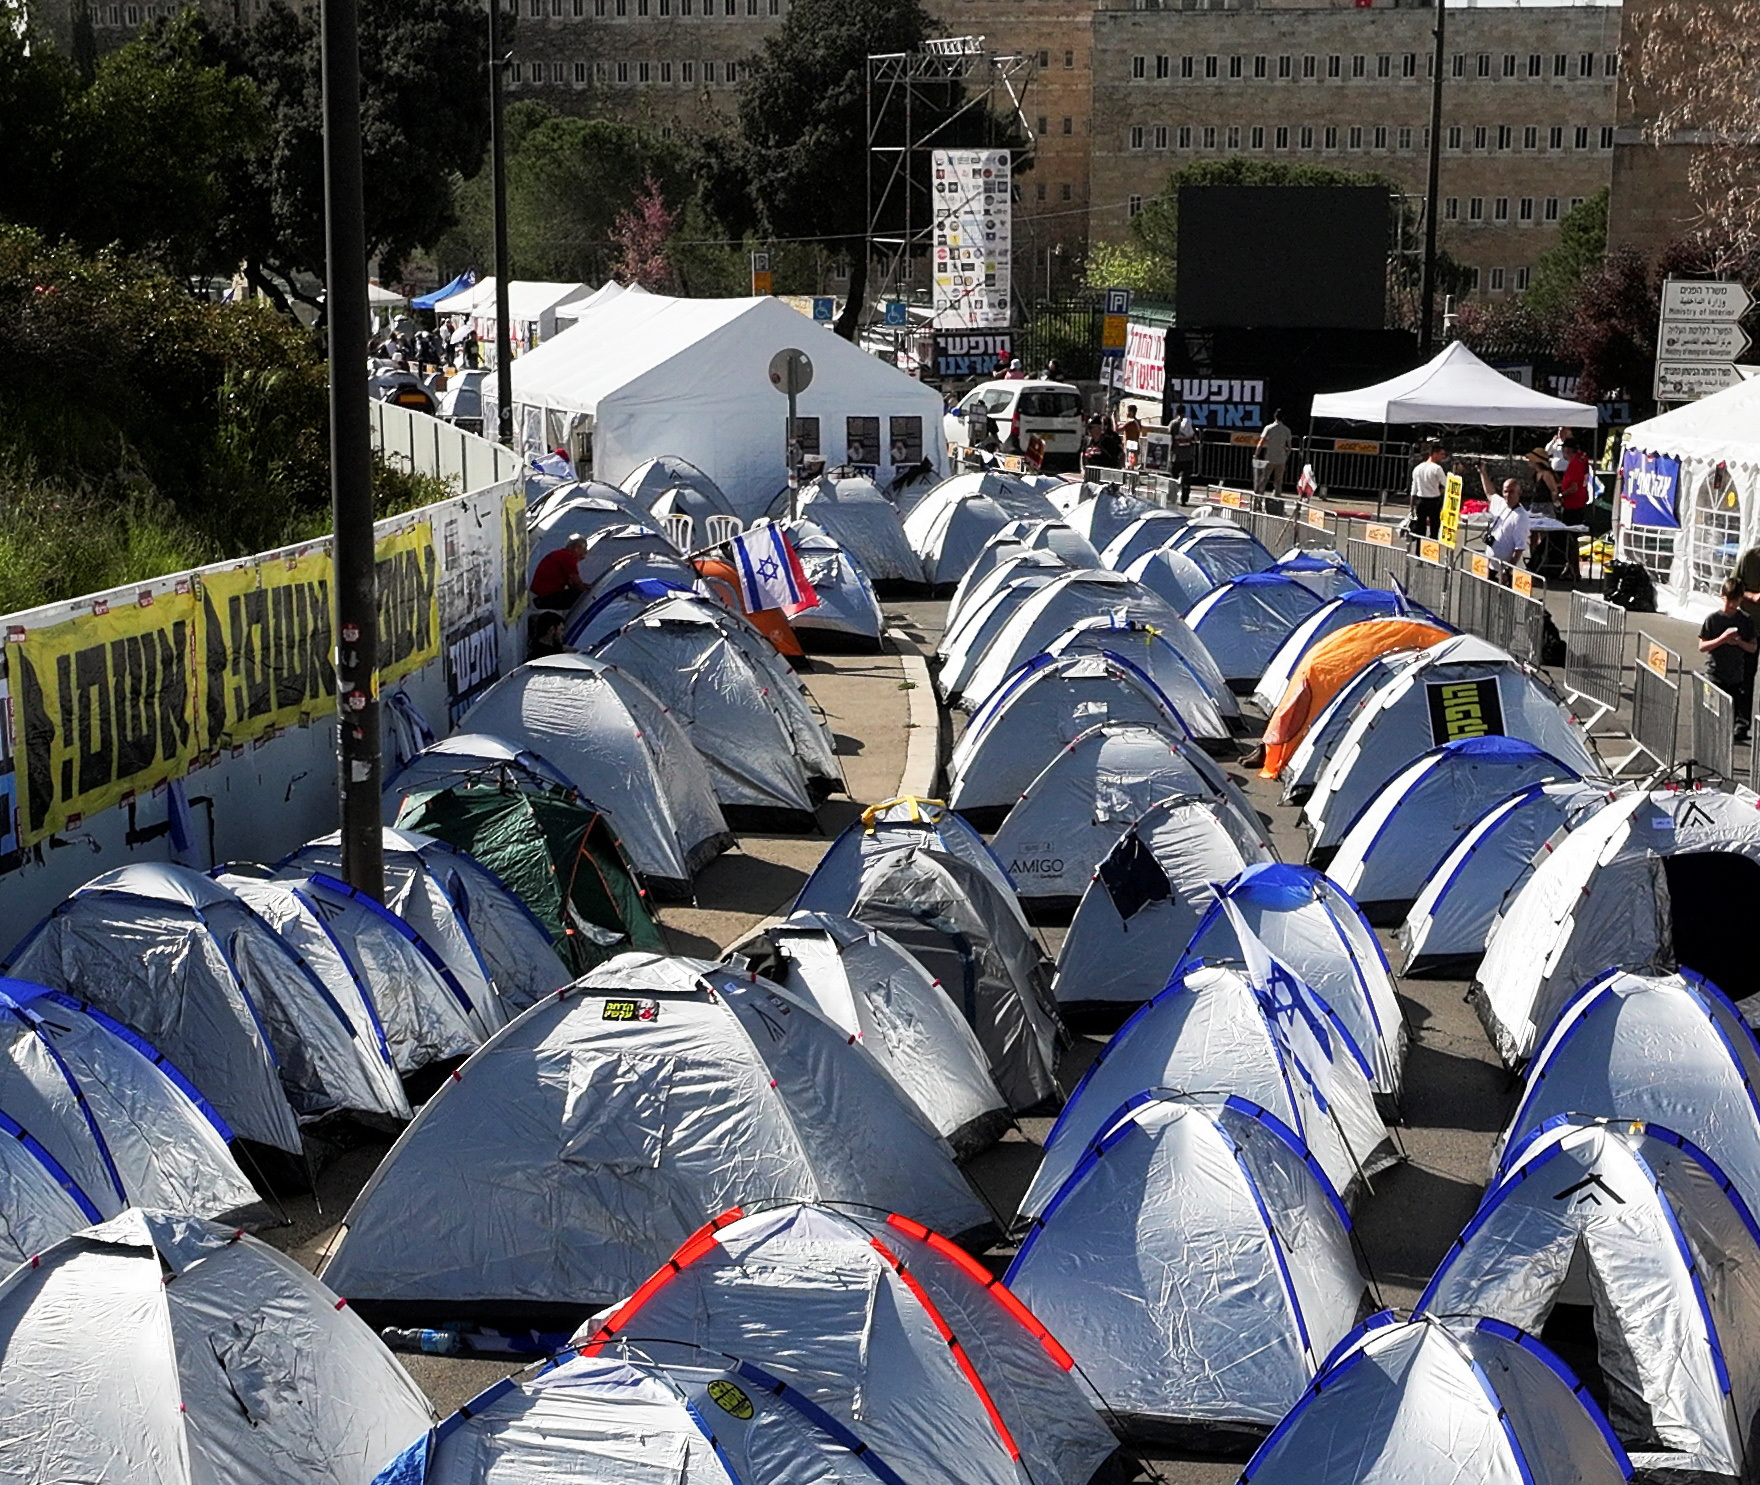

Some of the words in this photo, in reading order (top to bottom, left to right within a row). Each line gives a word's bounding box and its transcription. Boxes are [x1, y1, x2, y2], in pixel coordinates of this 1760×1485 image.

[1680, 286, 1703, 295] הפנים
[1705, 287, 1728, 295] משרד
[1669, 308, 1696, 316] Ministry
[937, 335, 1010, 355] חופשי
[938, 357, 998, 375] ארצנו
[1171, 379, 1265, 402] חופשי
[228, 579, 339, 723] אשם!
[57, 619, 190, 804] אשם!
[1008, 859, 1065, 874] AMIGO
